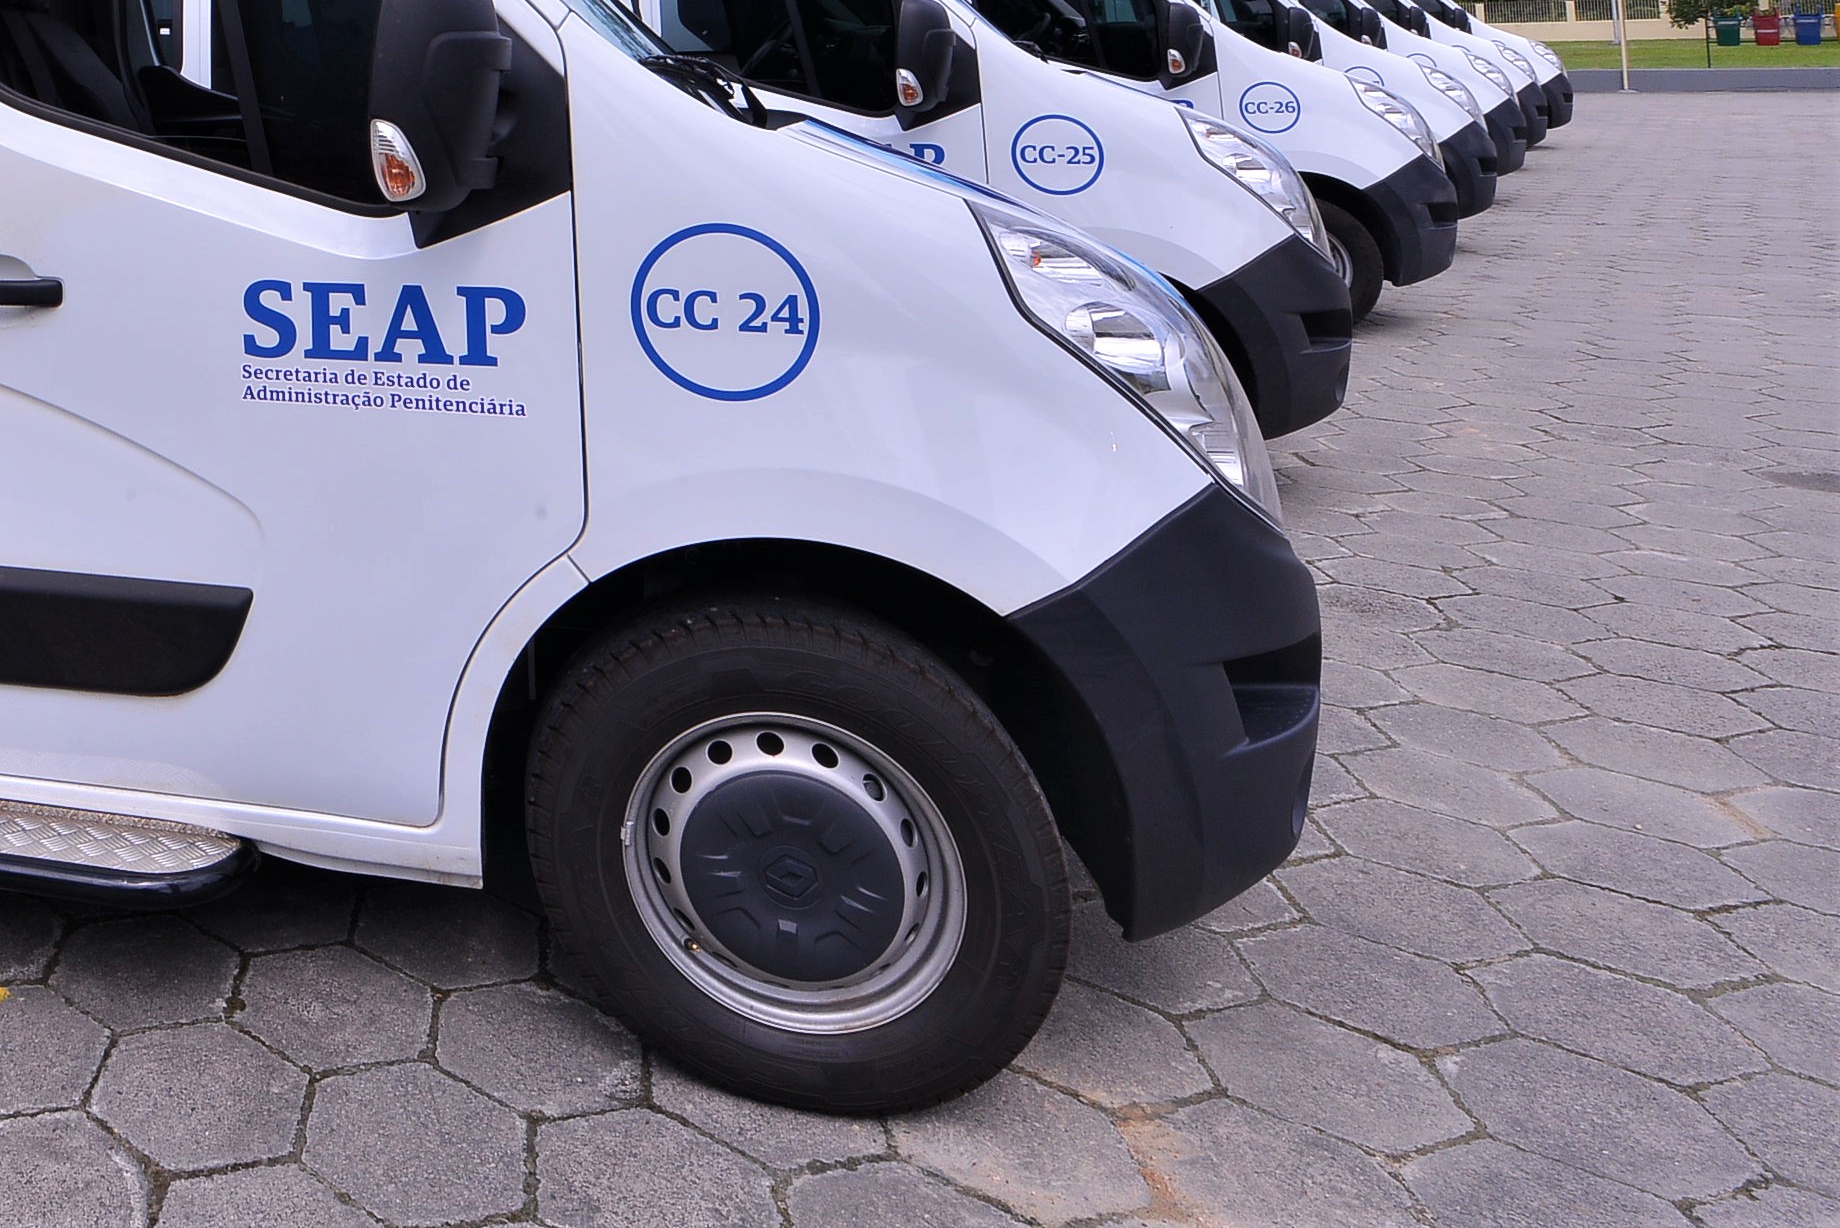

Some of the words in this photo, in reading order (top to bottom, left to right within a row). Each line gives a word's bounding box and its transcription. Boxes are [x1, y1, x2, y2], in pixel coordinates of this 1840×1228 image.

[1244, 101, 1296, 115] CC-26
[1019, 144, 1097, 167] CC-25
[243, 279, 527, 367] SEAP
[646, 288, 719, 332] CC
[738, 293, 806, 336] 24
[242, 364, 339, 384] Secretaria
[344, 369, 368, 385] de
[373, 371, 441, 390] Estado
[446, 374, 471, 391] de
[242, 385, 385, 410] Administração
[389, 392, 527, 417] Penitenciária
